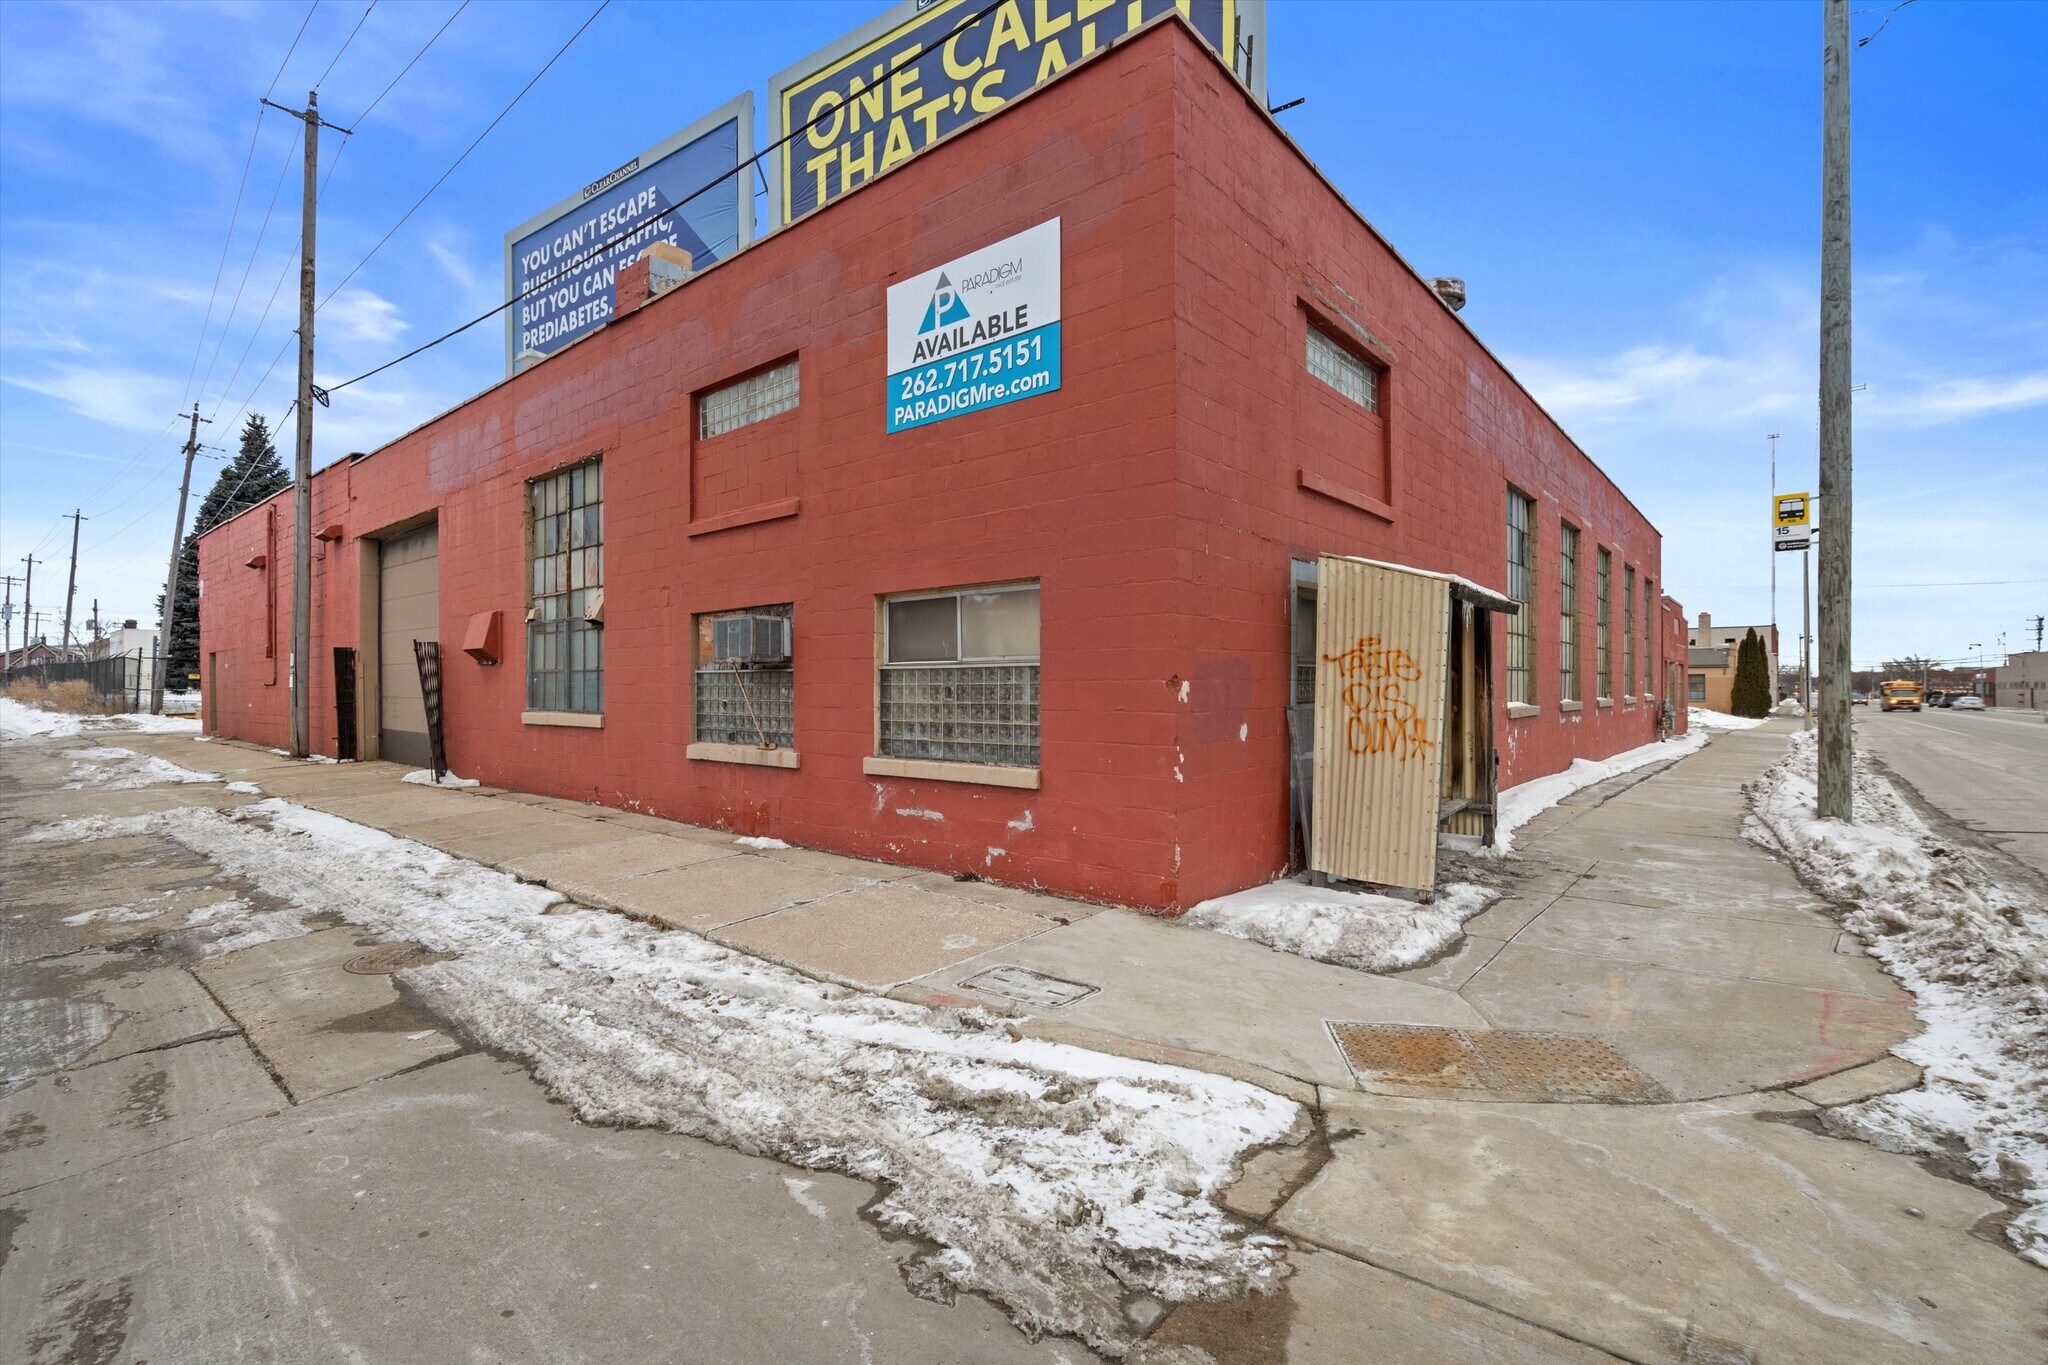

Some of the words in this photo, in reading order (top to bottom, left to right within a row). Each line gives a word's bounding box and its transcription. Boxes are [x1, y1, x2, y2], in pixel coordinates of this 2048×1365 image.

[806, 43, 922, 150] ONE
[806, 69, 1006, 206] THAT'S
[522, 244, 550, 275] YOU
[553, 218, 597, 258] CAN'T
[600, 185, 656, 235] ESCAPE
[522, 266, 558, 301] RUSH
[561, 243, 604, 282] HOUR
[607, 208, 674, 258] TRAFFIC,
[522, 298, 547, 326] BUT
[549, 282, 580, 313] YOU
[583, 264, 615, 296] CAN
[962, 258, 1022, 294] PARADIGM
[522, 295, 614, 351] PREDIABETES.
[912, 304, 1028, 364] AVAILABLE
[895, 370, 1050, 426] PARADIGMre.com
[902, 335, 1042, 400] 262.717.5151
[1776, 526, 1790, 535] 15
